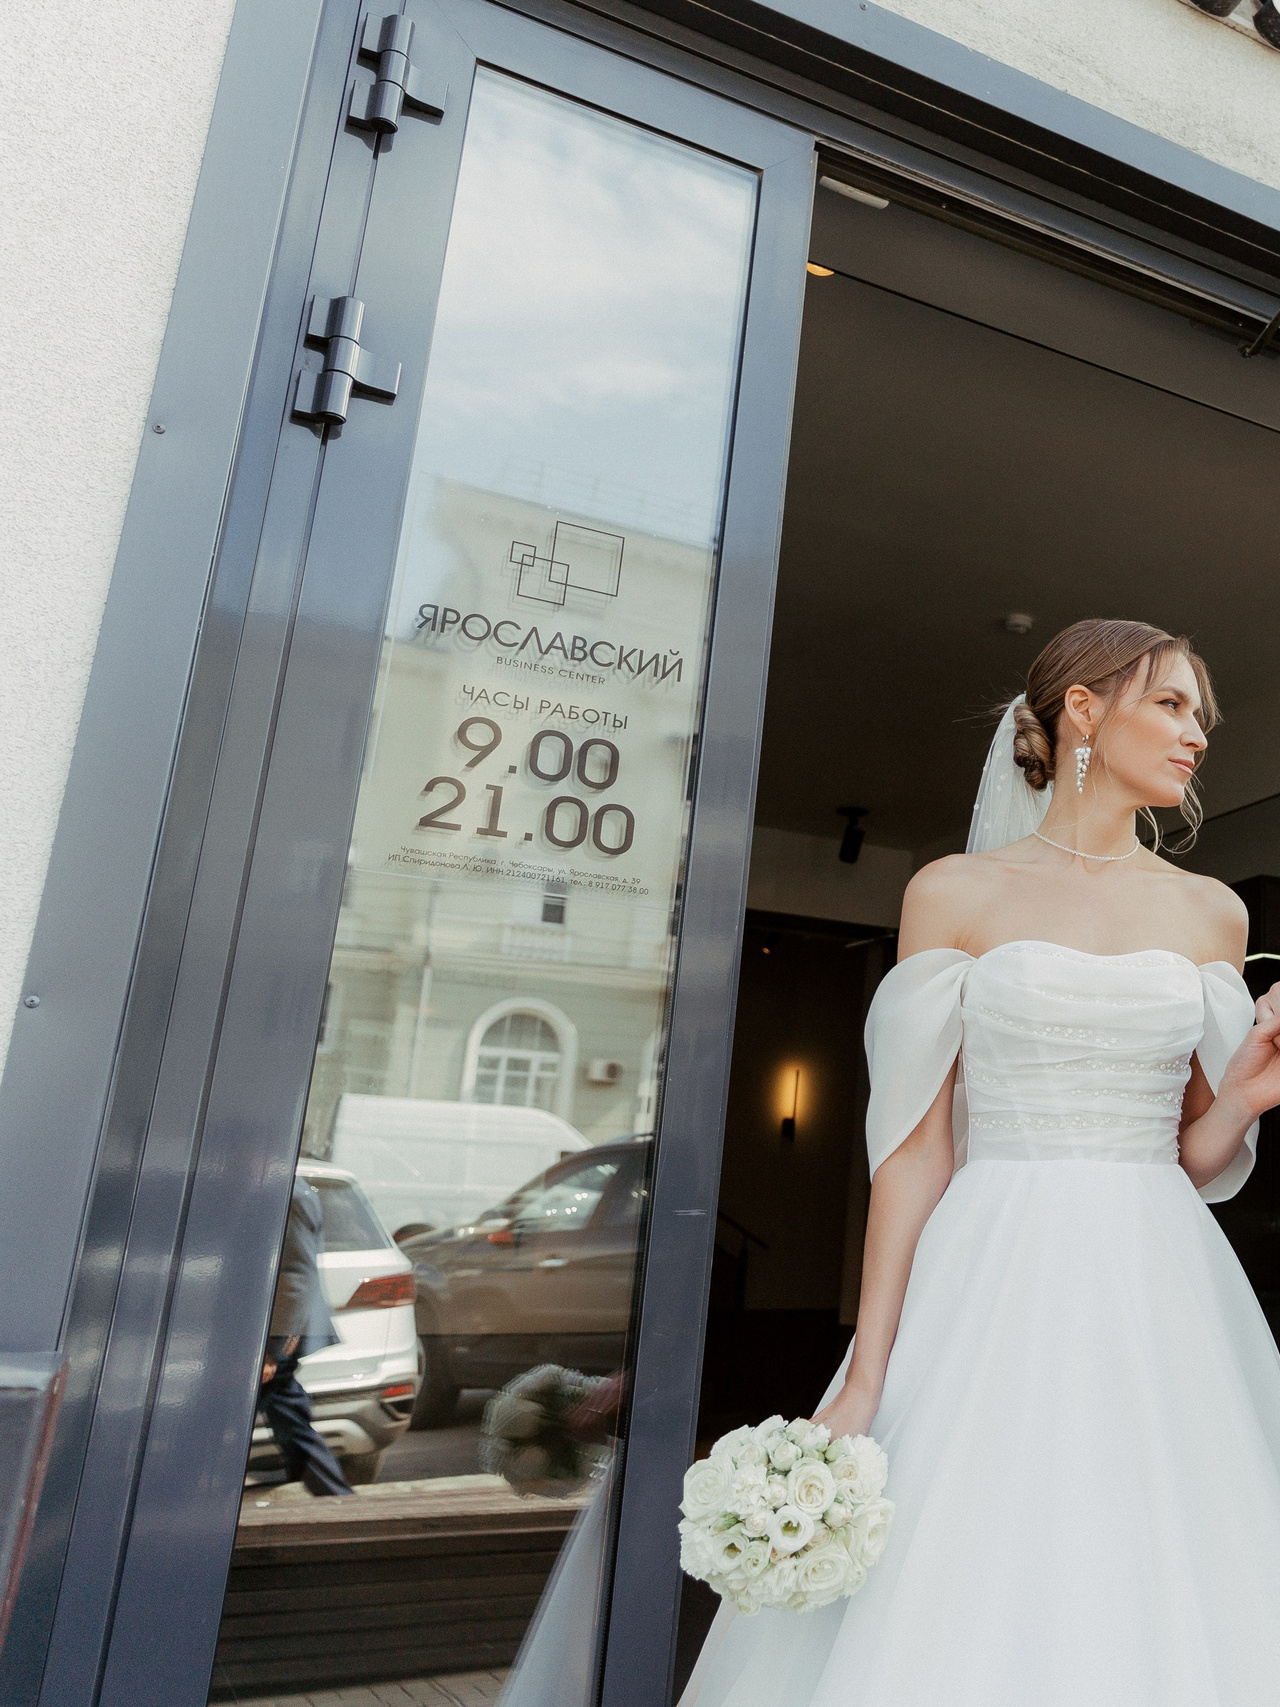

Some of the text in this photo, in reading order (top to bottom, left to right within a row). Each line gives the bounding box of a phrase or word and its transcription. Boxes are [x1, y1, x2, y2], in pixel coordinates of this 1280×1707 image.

[416, 603, 684, 682] ЯРОСЛАВСКИЙ
[496, 656, 606, 685] BUSINESS CENTER
[462, 684, 628, 730] ЧАСЫ РАБОТЫ
[457, 716, 620, 790] 9.00
[418, 776, 635, 855] 21.00
[388, 853, 401, 862] ИП
[402, 855, 461, 870] Спиридонова
[486, 866, 504, 876] ИНН
[595, 881, 609, 889] 917
[611, 883, 626, 892] 077
[627, 886, 637, 894] 38
[639, 887, 649, 896] 00
[400, 845, 447, 858] Чувашская
[449, 851, 498, 866] Республика,
[509, 860, 556, 874] Чебоксары,
[631, 877, 641, 885] 39
